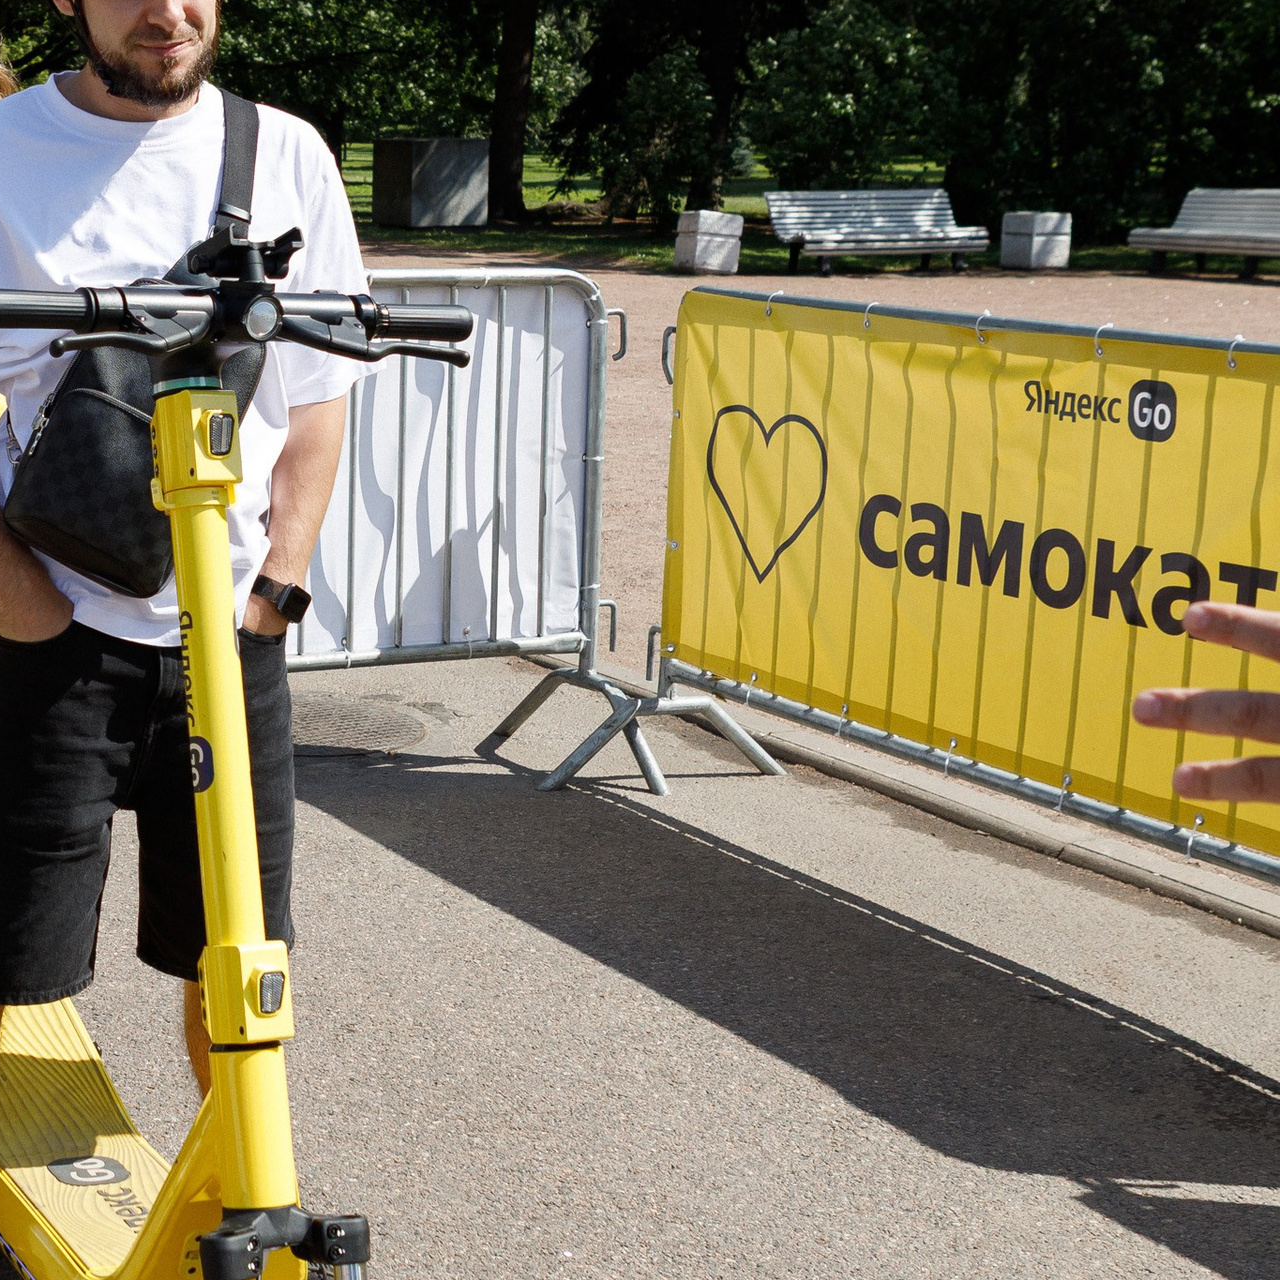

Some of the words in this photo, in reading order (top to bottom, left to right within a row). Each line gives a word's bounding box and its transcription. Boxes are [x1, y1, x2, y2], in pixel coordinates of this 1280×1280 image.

[1024, 380, 1122, 424] Яндекс
[1133, 391, 1172, 431] Go
[70, 1158, 115, 1182] Go
[97, 1186, 149, 1234] декс
